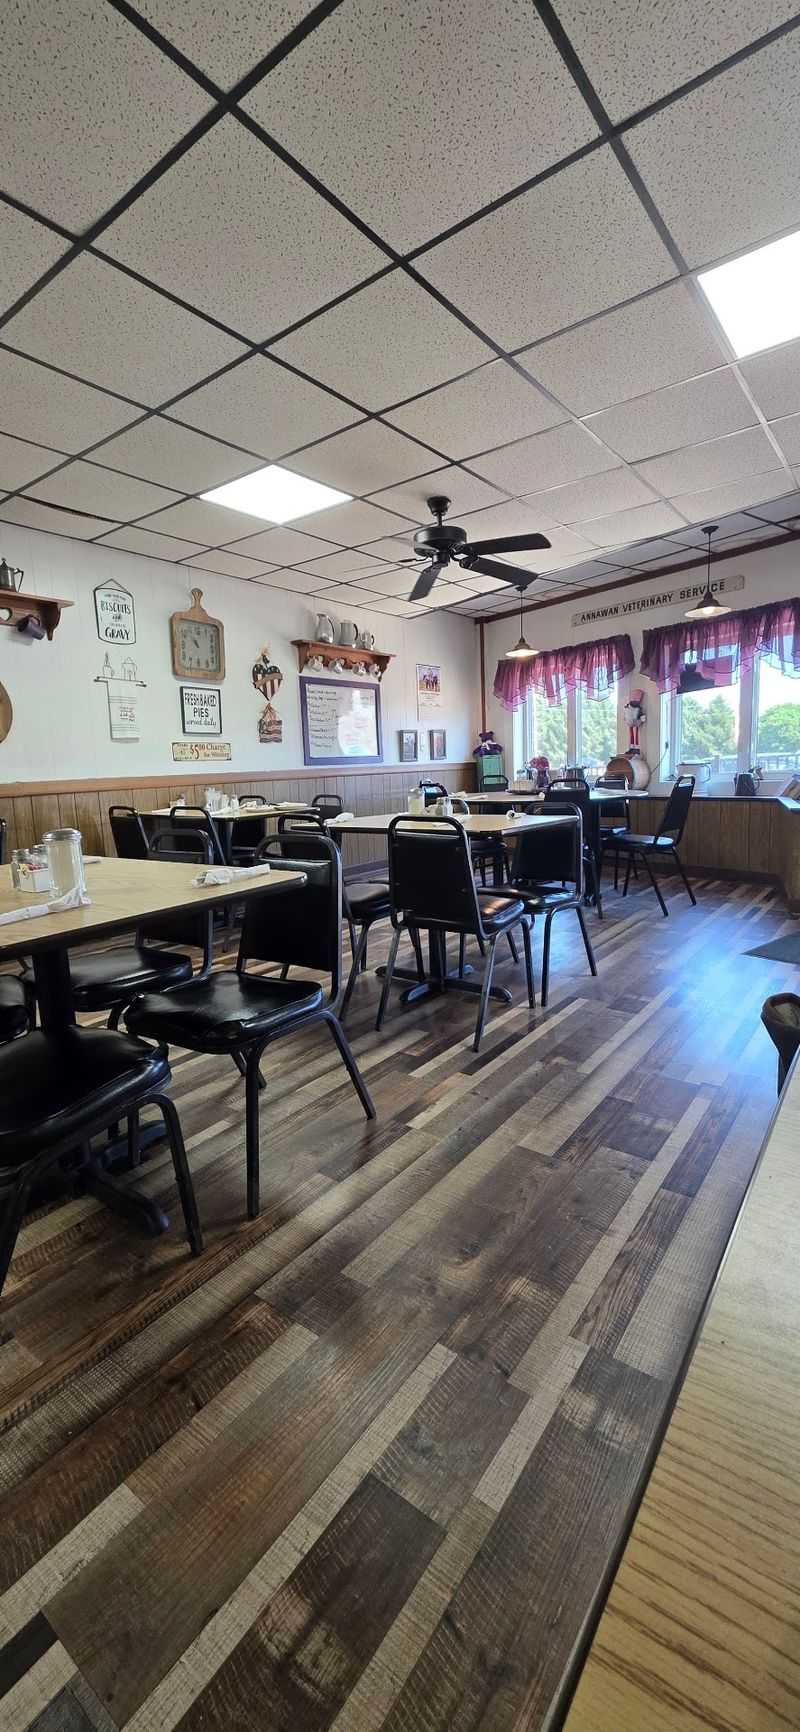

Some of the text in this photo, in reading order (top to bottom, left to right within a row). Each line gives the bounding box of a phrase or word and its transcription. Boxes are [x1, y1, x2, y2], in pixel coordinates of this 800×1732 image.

[100, 600, 131, 615] BISCUITS
[580, 606, 619, 622] ANNAWAN
[622, 593, 674, 612] VETERINARY
[105, 626, 130, 641] GRAVY
[185, 692, 217, 707] FRESH BAKED
[193, 707, 209, 718] PIES
